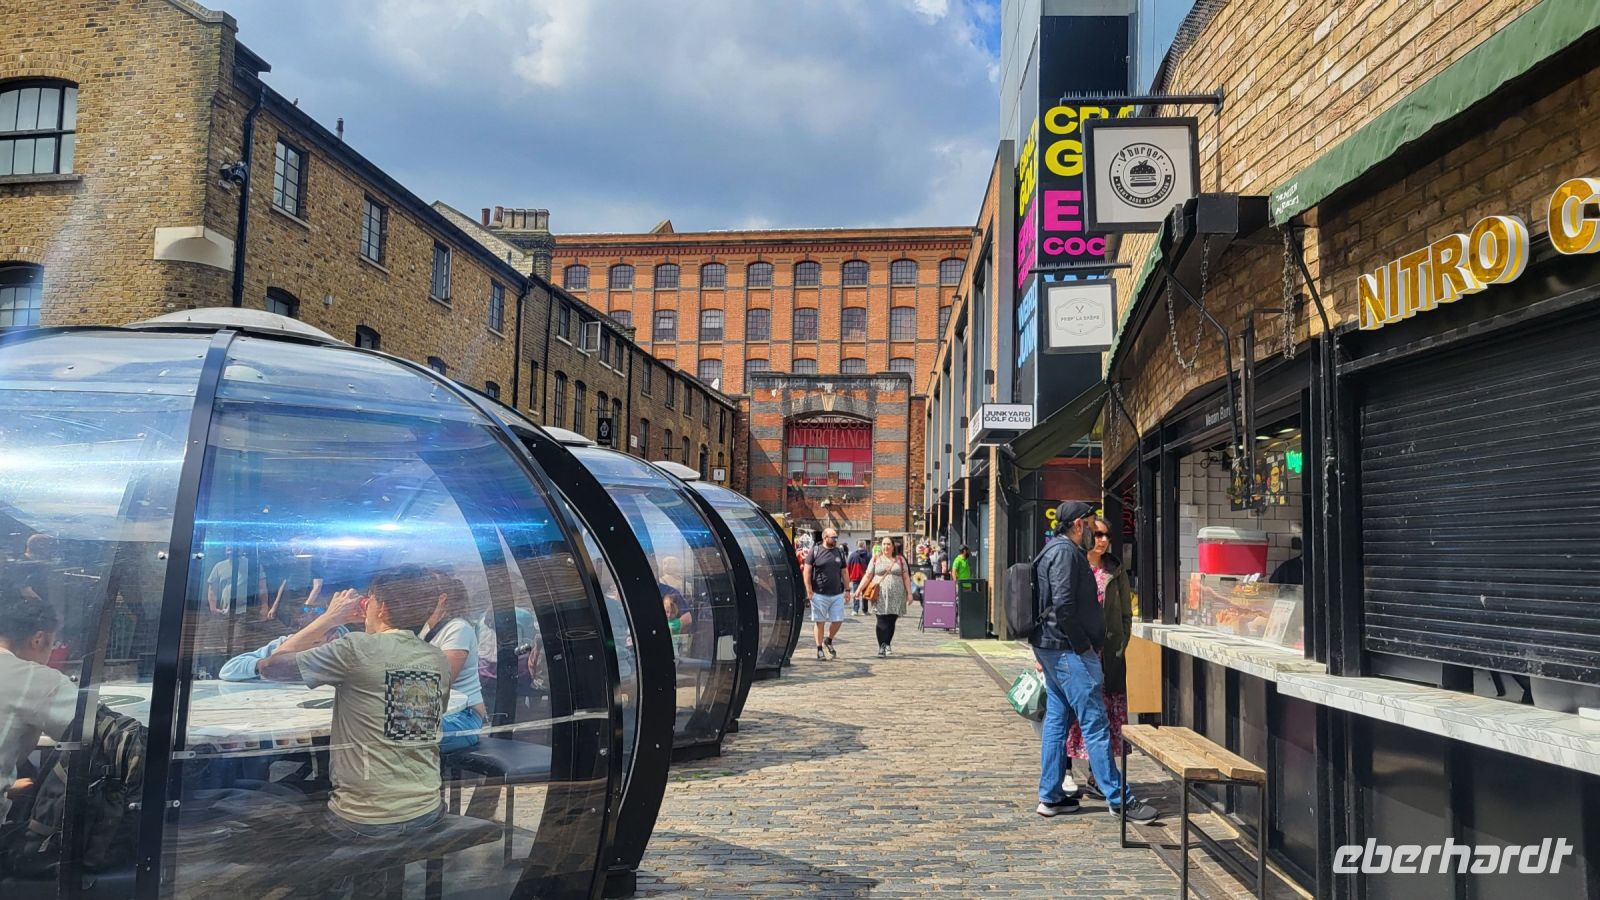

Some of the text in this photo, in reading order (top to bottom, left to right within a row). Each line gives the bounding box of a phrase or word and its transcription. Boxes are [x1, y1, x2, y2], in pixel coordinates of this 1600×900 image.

[1126, 146, 1164, 161] burger
[1357, 215, 1530, 331] NITRO
[788, 429, 870, 448] INTERCHANGE
